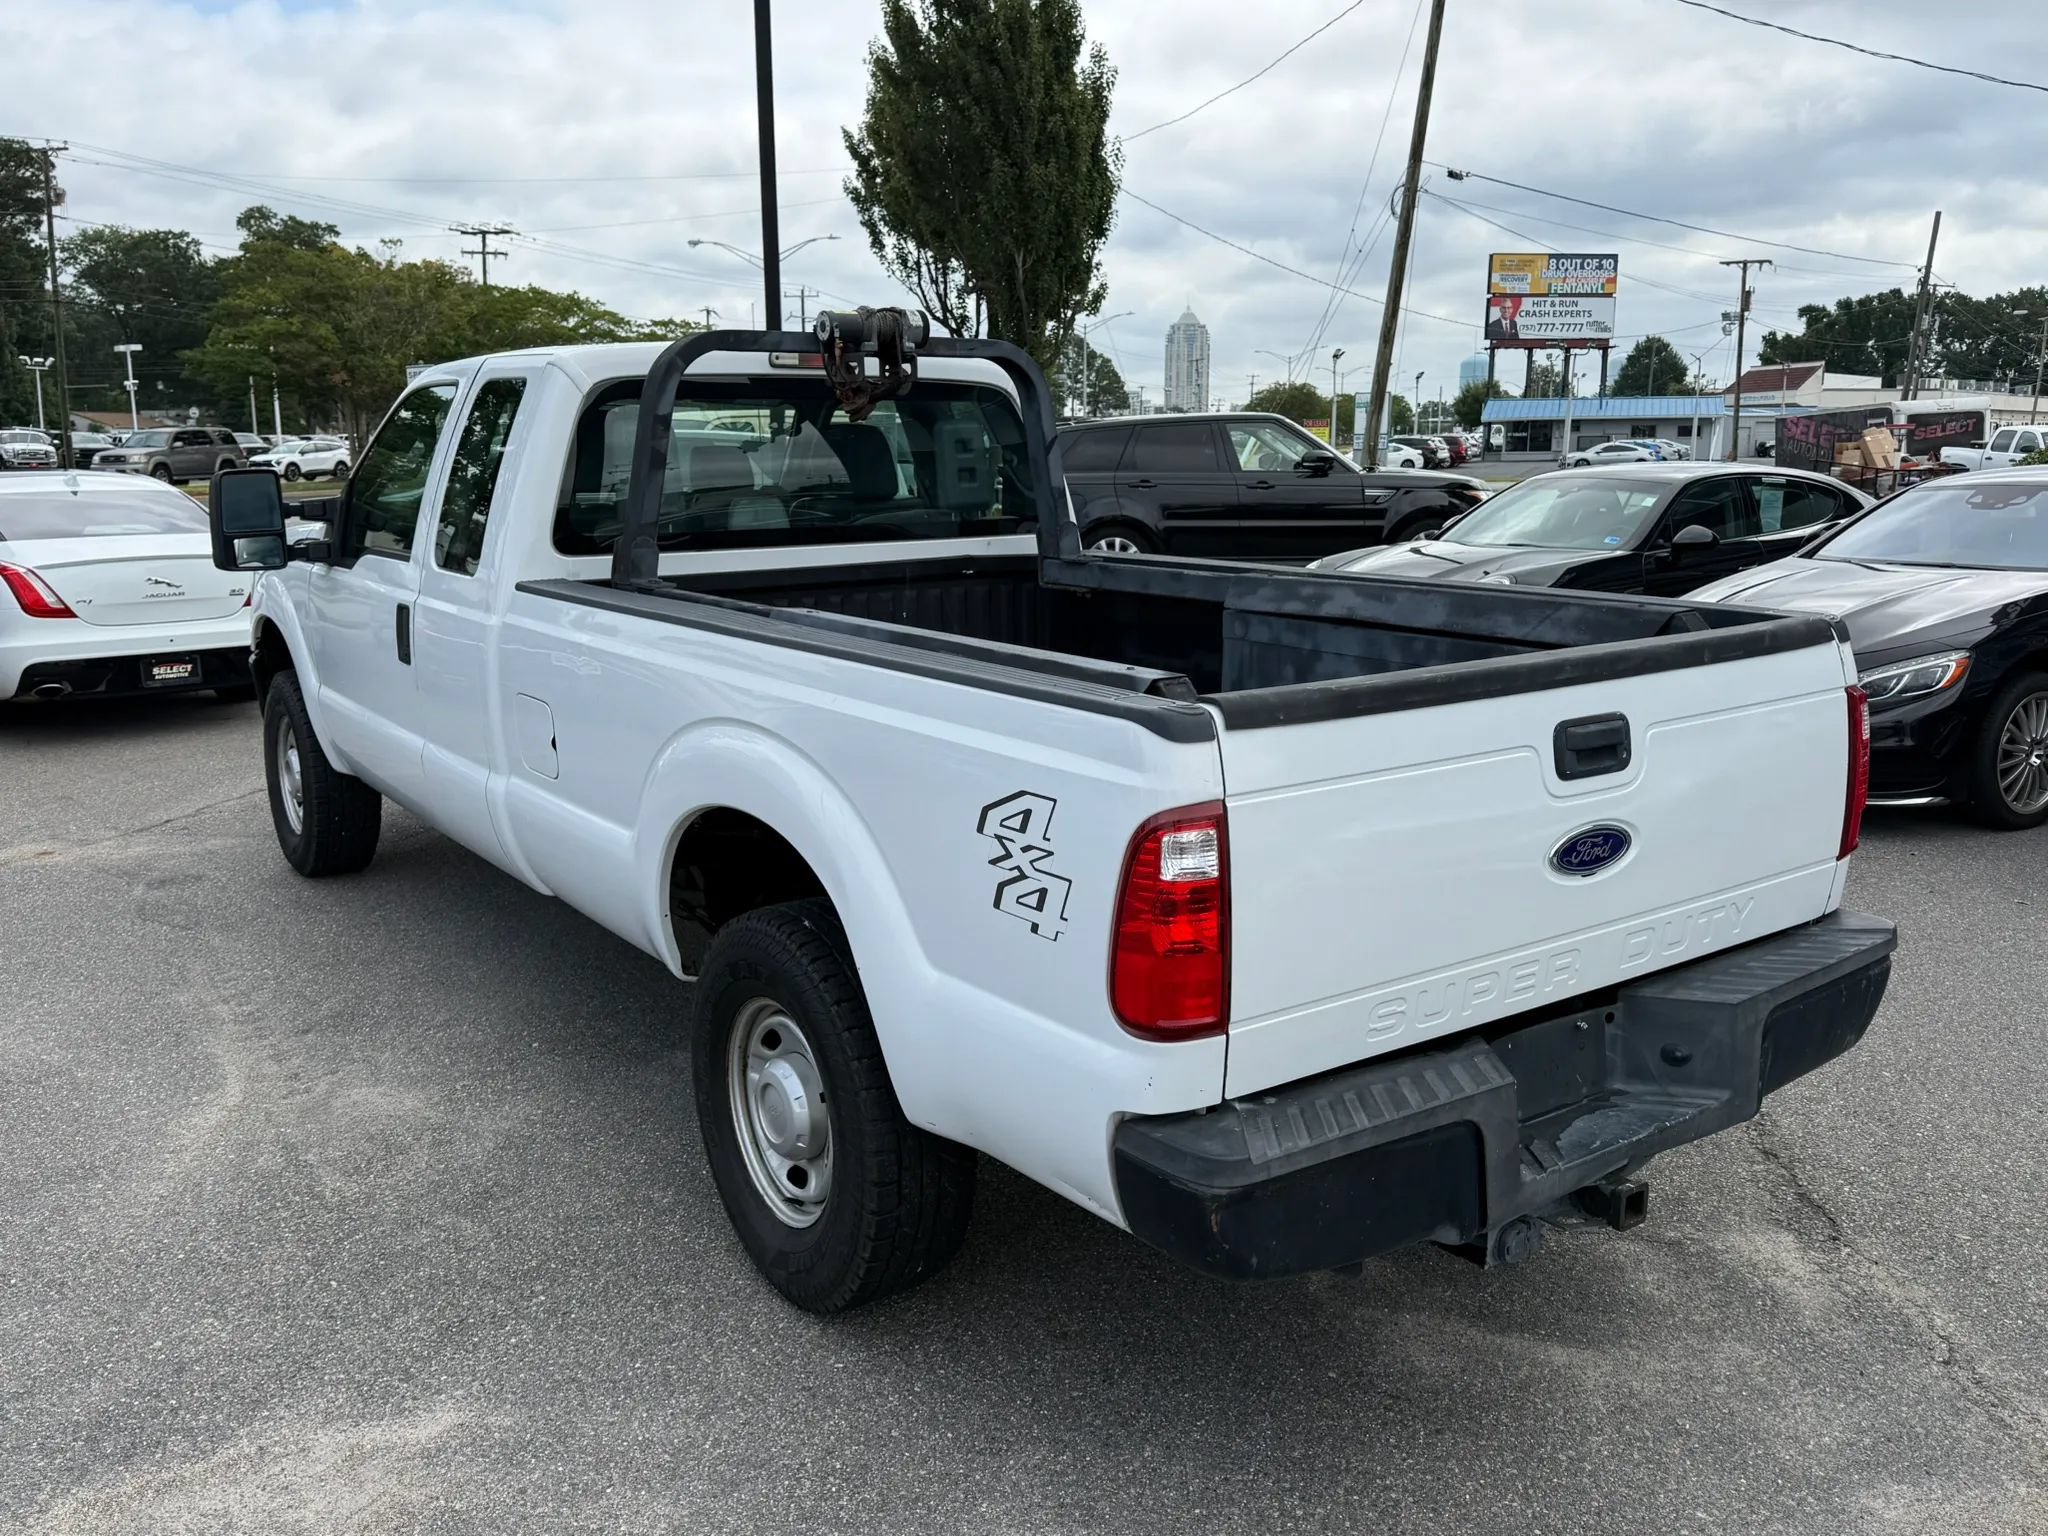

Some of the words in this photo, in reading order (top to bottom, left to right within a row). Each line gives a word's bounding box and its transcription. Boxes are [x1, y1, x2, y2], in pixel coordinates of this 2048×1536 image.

[1549, 258, 1557, 270] 8
[1558, 258, 1581, 270] OUT
[1584, 258, 1599, 270] OF
[1601, 258, 1614, 270] 10
[1542, 269, 1565, 278] DRUG
[1567, 269, 1615, 278] OVERDOSES
[1551, 282, 1604, 293] FENTANYL
[1532, 300, 1548, 308] HIT
[1549, 300, 1557, 308] &
[1559, 300, 1578, 308] RUN
[1518, 309, 1550, 318] CRASH
[1553, 309, 1592, 318] EXPERTS
[1519, 325, 1536, 333] (757)
[1537, 323, 1584, 332] 777-7777
[1914, 419, 1976, 440] SELECT
[142, 591, 186, 599] JAGUAR
[152, 664, 193, 675] SELECT
[155, 672, 189, 680] AUTOMOTIVE
[1563, 835, 1612, 864] Ford
[1366, 948, 1581, 1042] SUPER
[1619, 896, 1755, 969] DUTY
